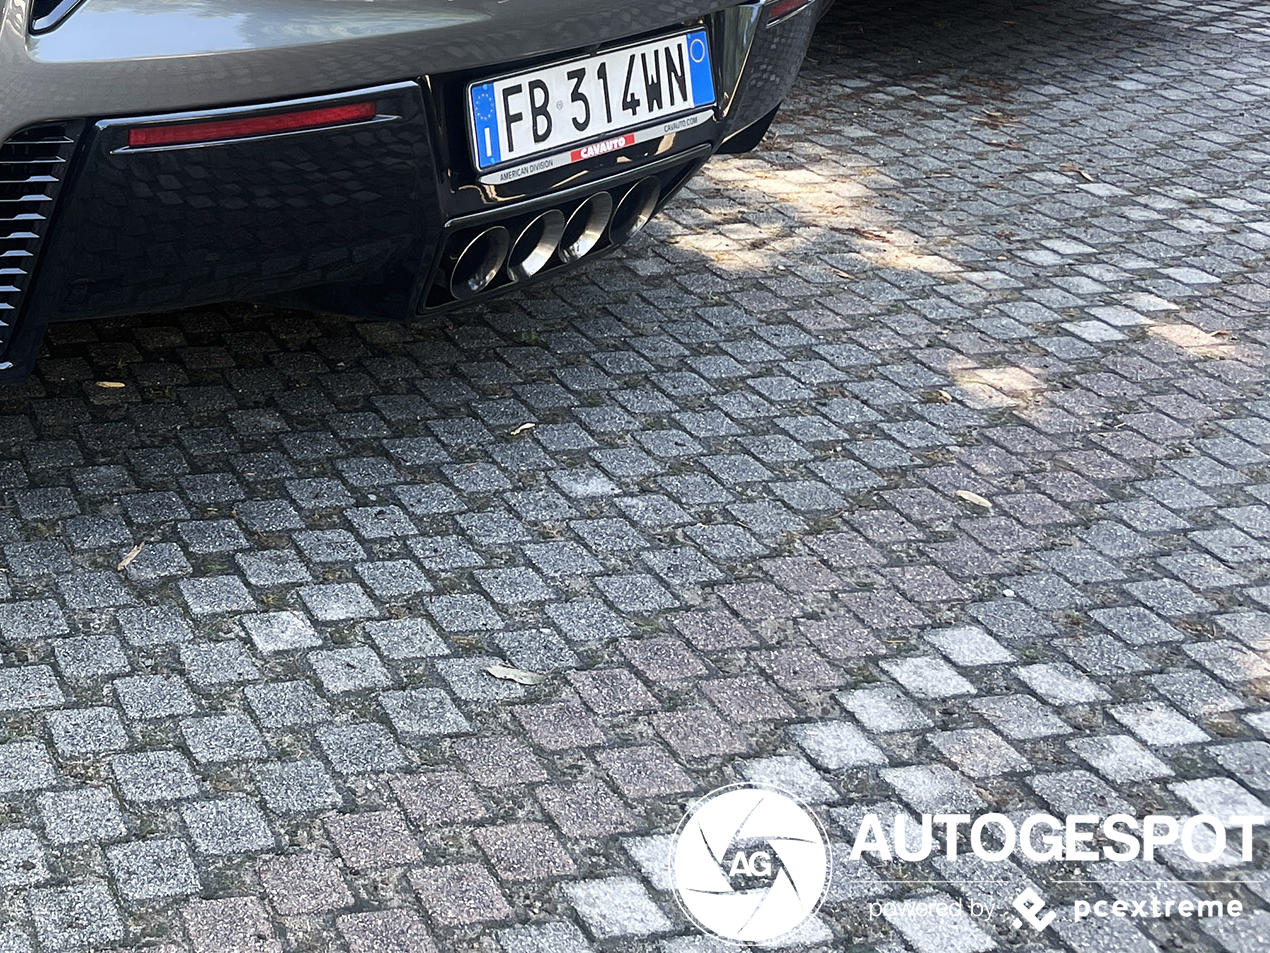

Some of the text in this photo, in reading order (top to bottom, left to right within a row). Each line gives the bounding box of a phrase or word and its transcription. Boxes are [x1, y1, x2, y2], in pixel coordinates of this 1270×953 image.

[501, 43, 689, 153] FB 314WN
[663, 116, 698, 133] CAVAUTO.COM
[580, 136, 626, 159] CAVAUTO
[499, 160, 554, 182] AMERICAN DIVISION
